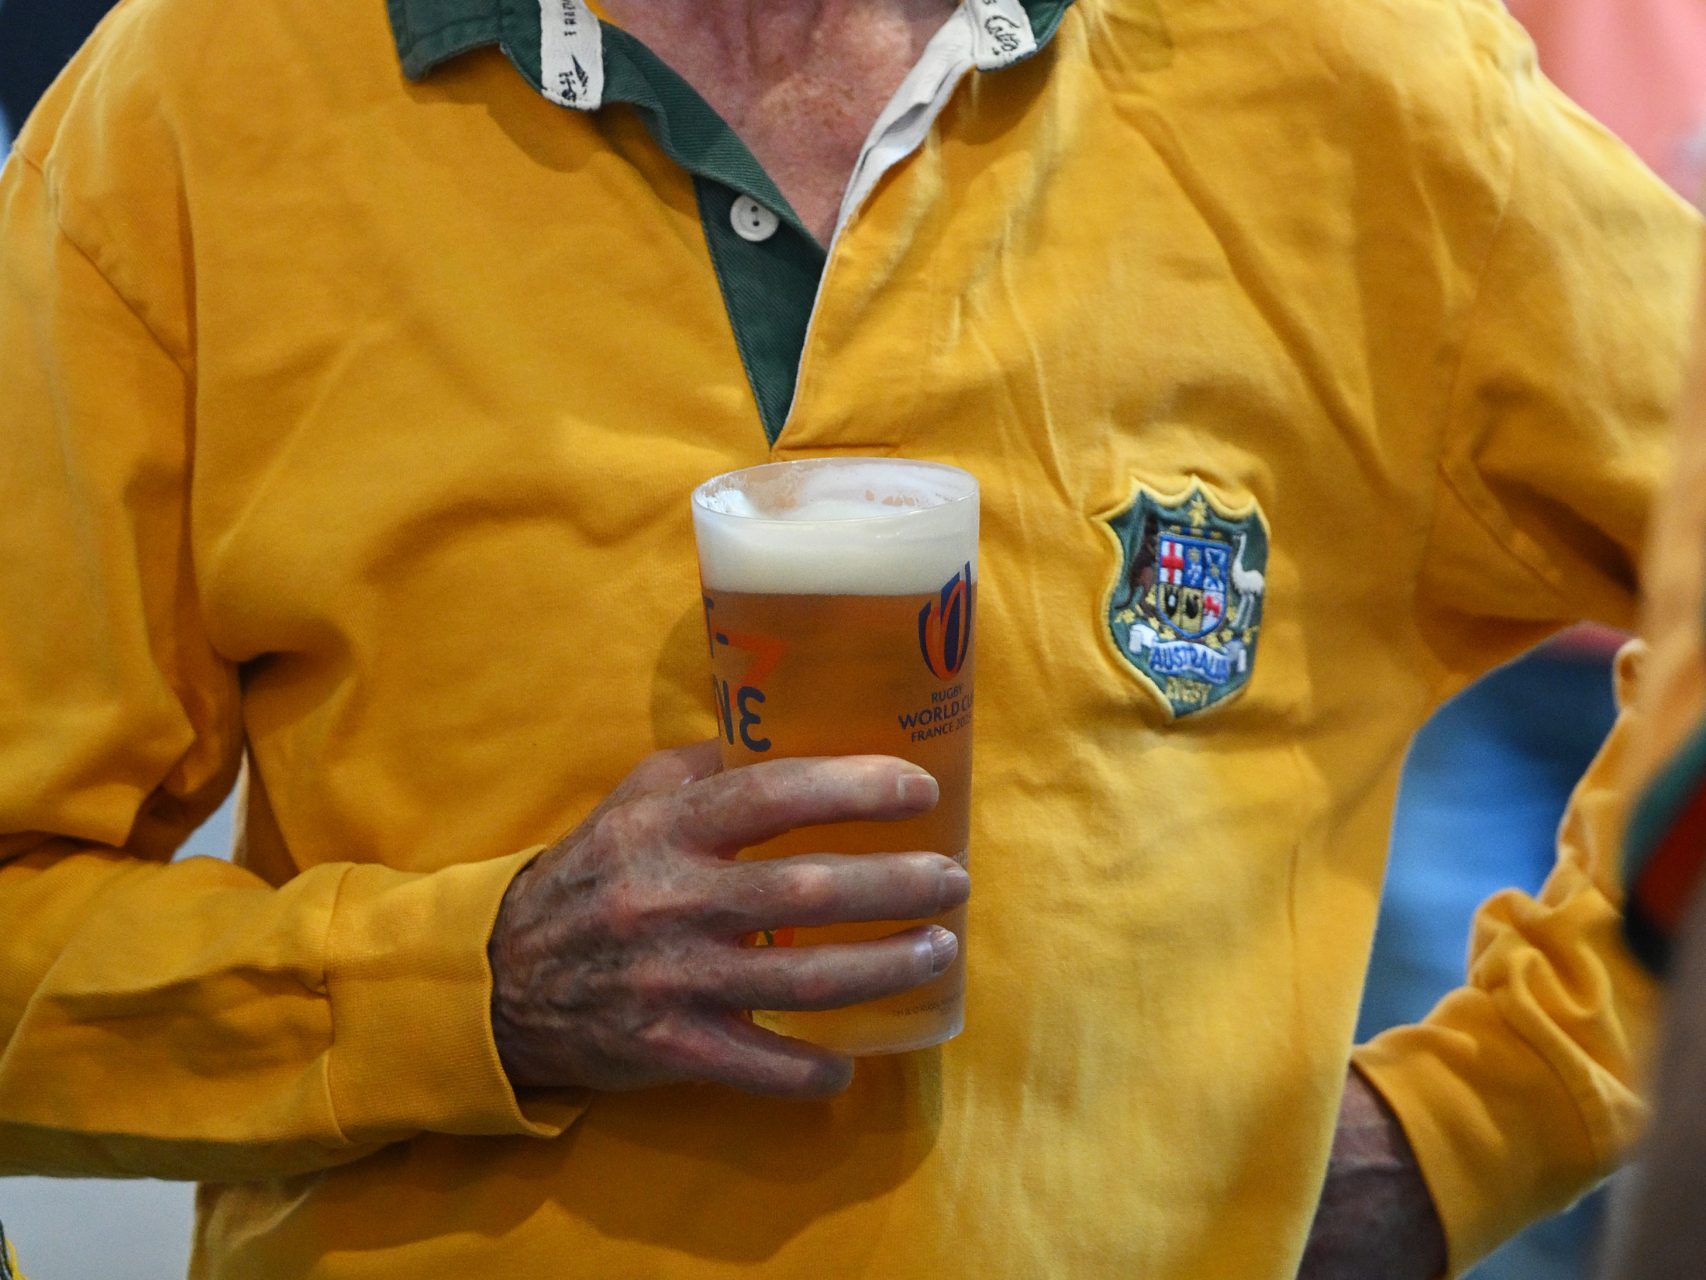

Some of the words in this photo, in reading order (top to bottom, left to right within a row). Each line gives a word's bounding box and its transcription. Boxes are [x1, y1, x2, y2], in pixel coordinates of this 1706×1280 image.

[931, 685, 963, 704] RUGBY
[898, 700, 960, 730] WORLD
[911, 722, 954, 742] FRANCE
